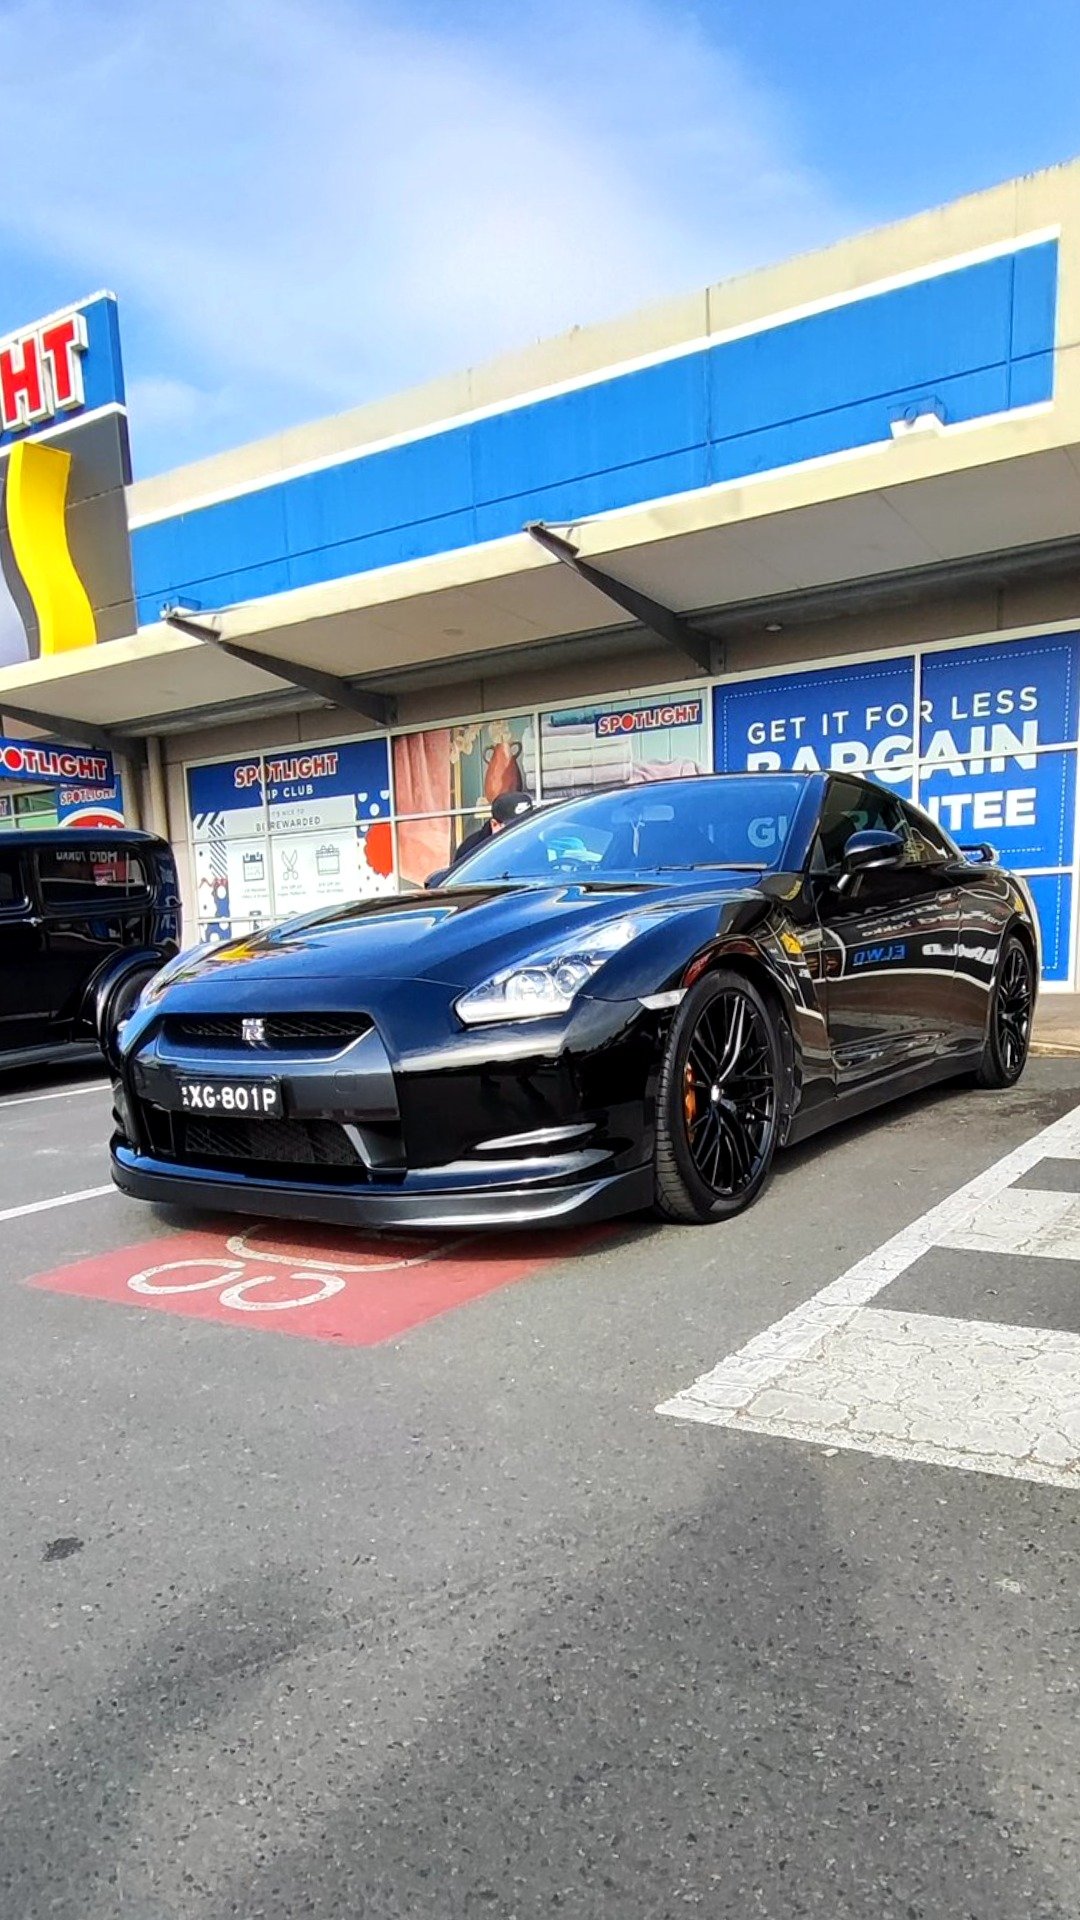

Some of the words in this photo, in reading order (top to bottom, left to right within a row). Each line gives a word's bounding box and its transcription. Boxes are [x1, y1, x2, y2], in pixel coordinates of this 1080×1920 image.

[0, 312, 89, 431] HT
[598, 703, 700, 734] SPOTLIGHT
[747, 716, 806, 745] GET
[821, 710, 849, 736] IT
[866, 699, 934, 731] FOR
[952, 686, 1039, 720] LESS
[0, 746, 107, 780] OTLIGHT
[234, 752, 338, 788] SPOTLIGHT
[283, 784, 314, 798] CLUB
